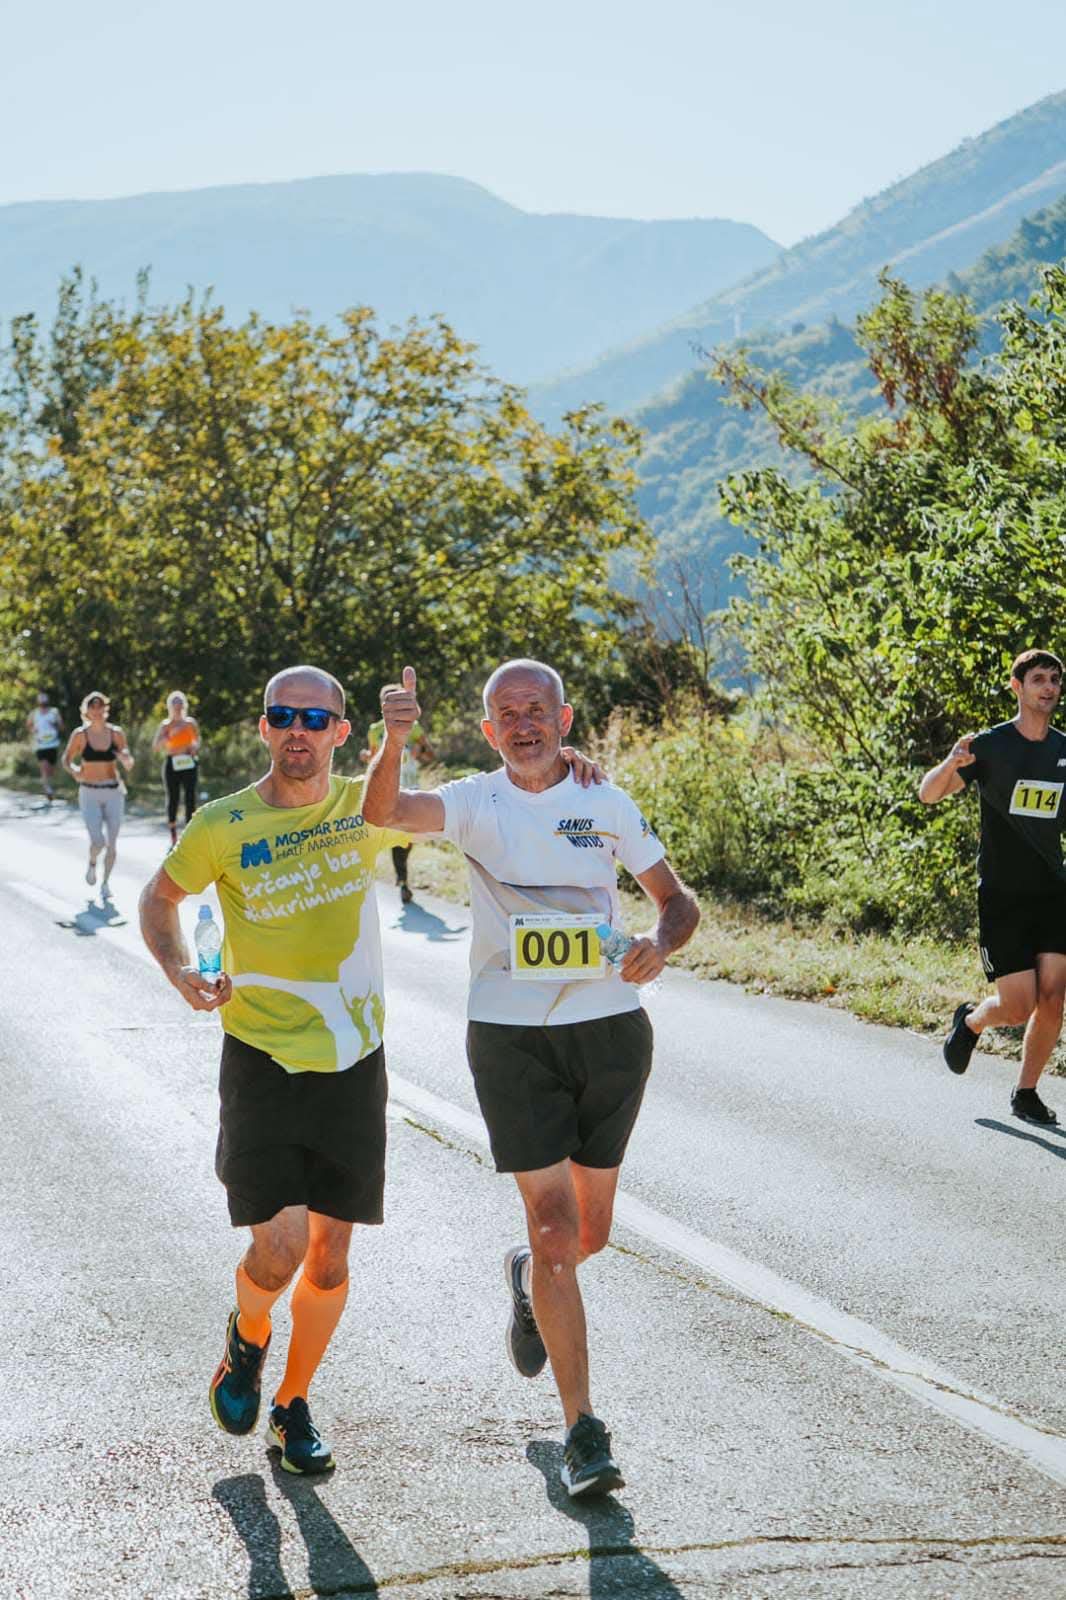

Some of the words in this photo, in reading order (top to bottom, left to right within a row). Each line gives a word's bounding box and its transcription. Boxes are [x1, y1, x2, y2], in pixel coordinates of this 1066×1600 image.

[1021, 788, 1057, 811] 114
[275, 822, 332, 848] MOSTAR
[334, 815, 365, 832] 2020
[557, 818, 594, 832] SANUS
[276, 843, 305, 860] HALF
[308, 828, 369, 852] MARATHON
[566, 835, 604, 849] MOTUS
[324, 849, 362, 873] bez
[522, 930, 589, 966] 001
